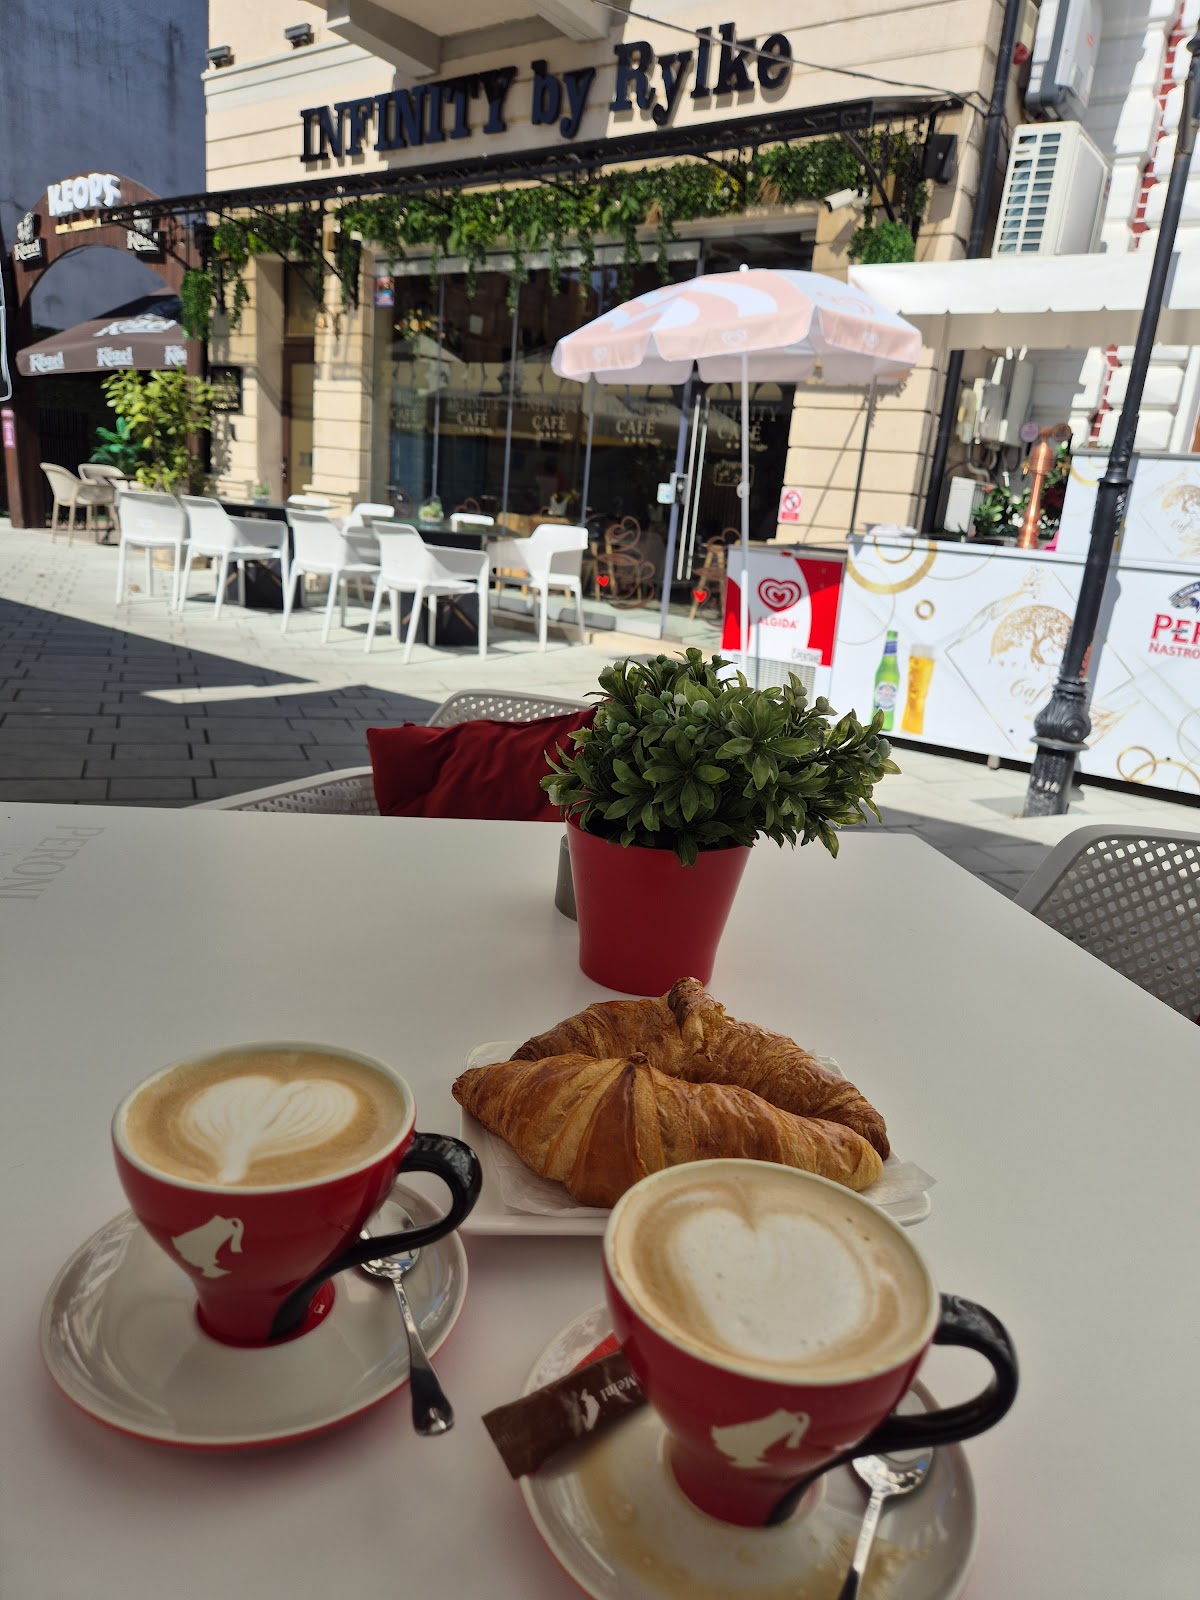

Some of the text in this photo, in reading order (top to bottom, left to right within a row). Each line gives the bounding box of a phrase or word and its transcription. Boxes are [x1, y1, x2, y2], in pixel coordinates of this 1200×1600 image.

[300, 22, 793, 163] INFINITY by Rylke
[47, 173, 121, 217] KEOPS
[717, 421, 761, 442] CAÉ
